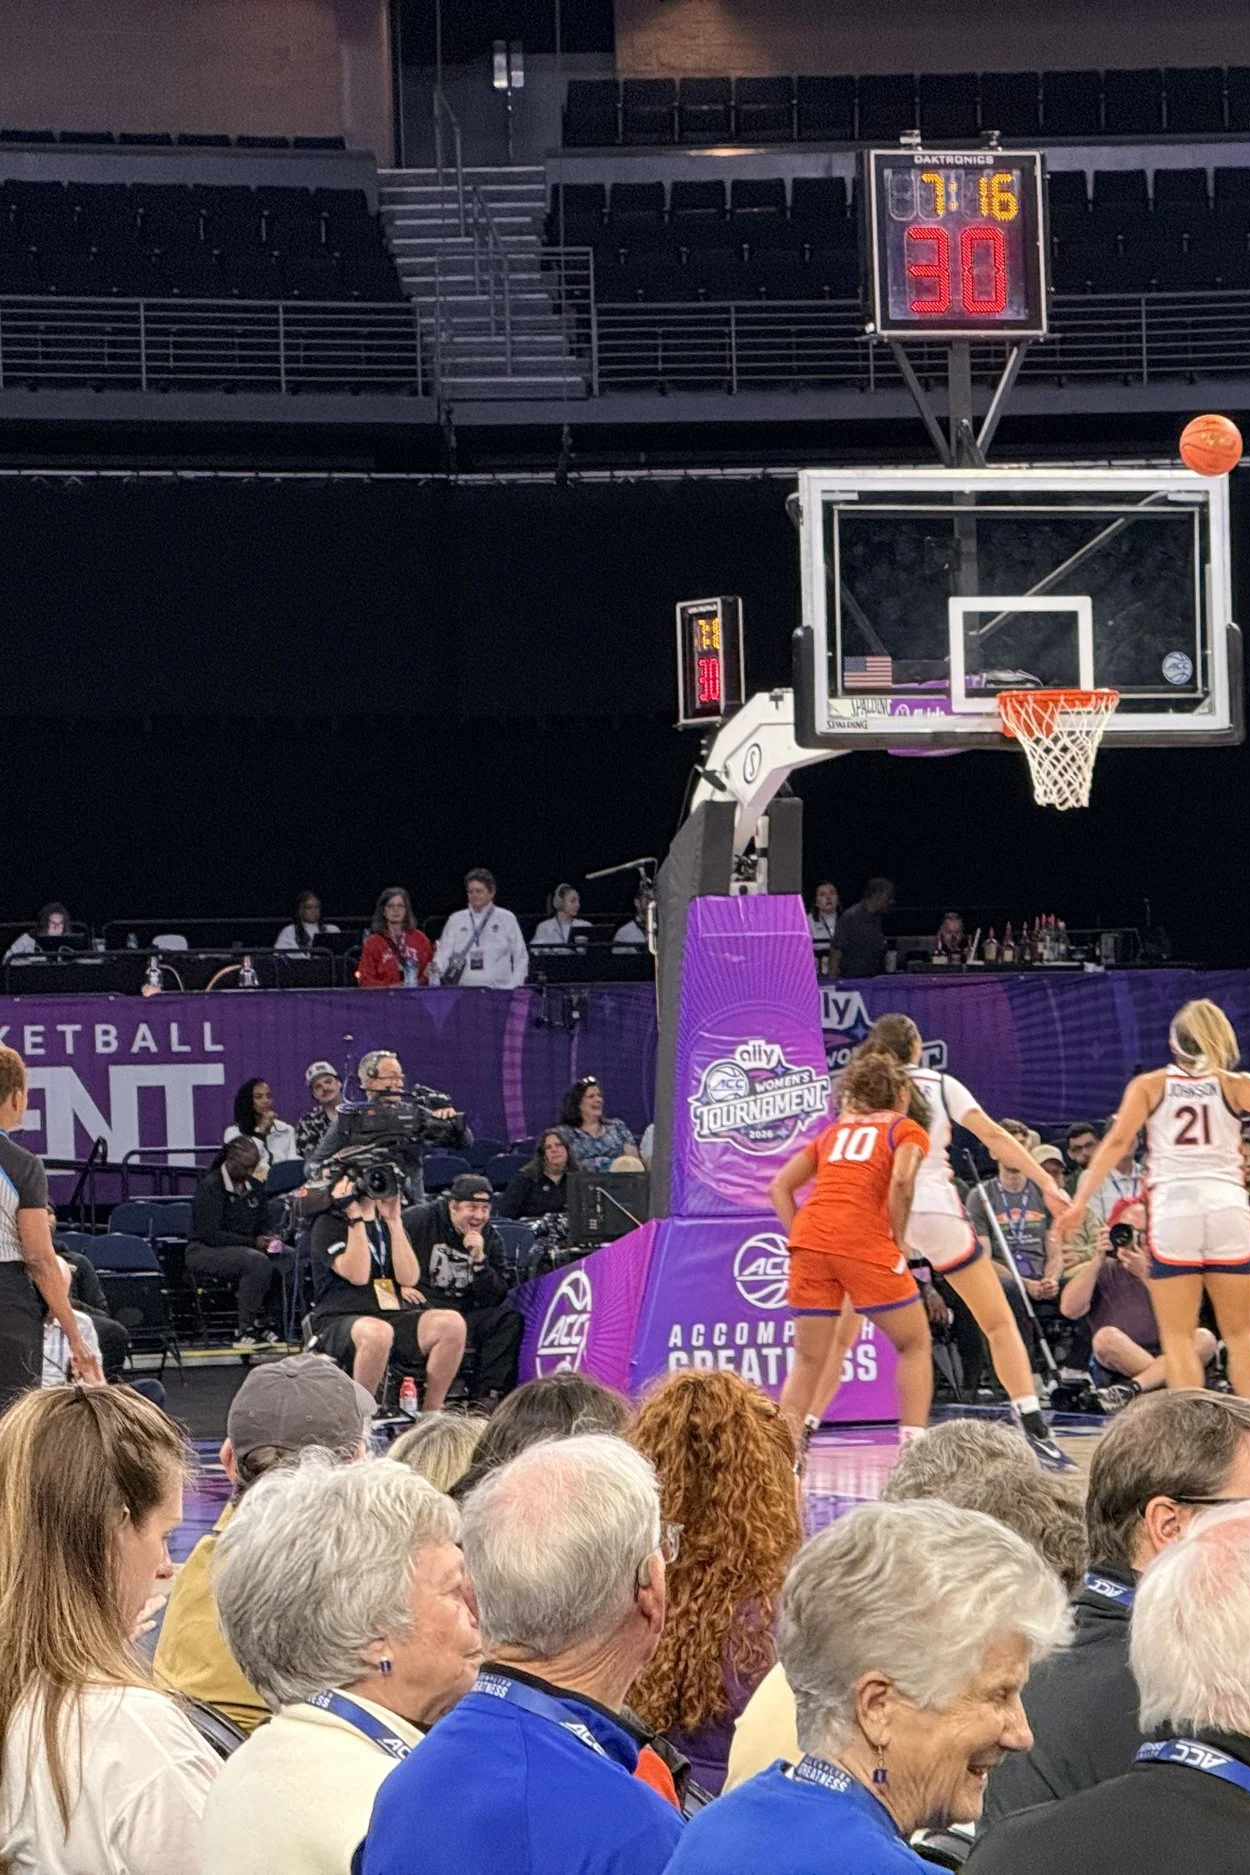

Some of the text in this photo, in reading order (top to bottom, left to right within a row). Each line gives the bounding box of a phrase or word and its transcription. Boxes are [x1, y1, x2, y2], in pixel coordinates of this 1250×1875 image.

[914, 155, 995, 165] DAKTRONICS
[920, 172, 1020, 222] 7:16
[907, 227, 1007, 314] 30
[698, 658, 720, 701] 30
[827, 720, 868, 730] SPALDING
[739, 1044, 775, 1065] ally
[715, 1071, 811, 1093] ACC WOMEN'S
[696, 1080, 828, 1136] TOURNAMENT
[749, 1129, 774, 1139] 2026
[1174, 1104, 1212, 1145] 21
[828, 1125, 880, 1163] 10
[543, 1312, 592, 1346] ACC
[668, 1318, 875, 1348] ACCOMPH
[1169, 1742, 1228, 1770] ACC
